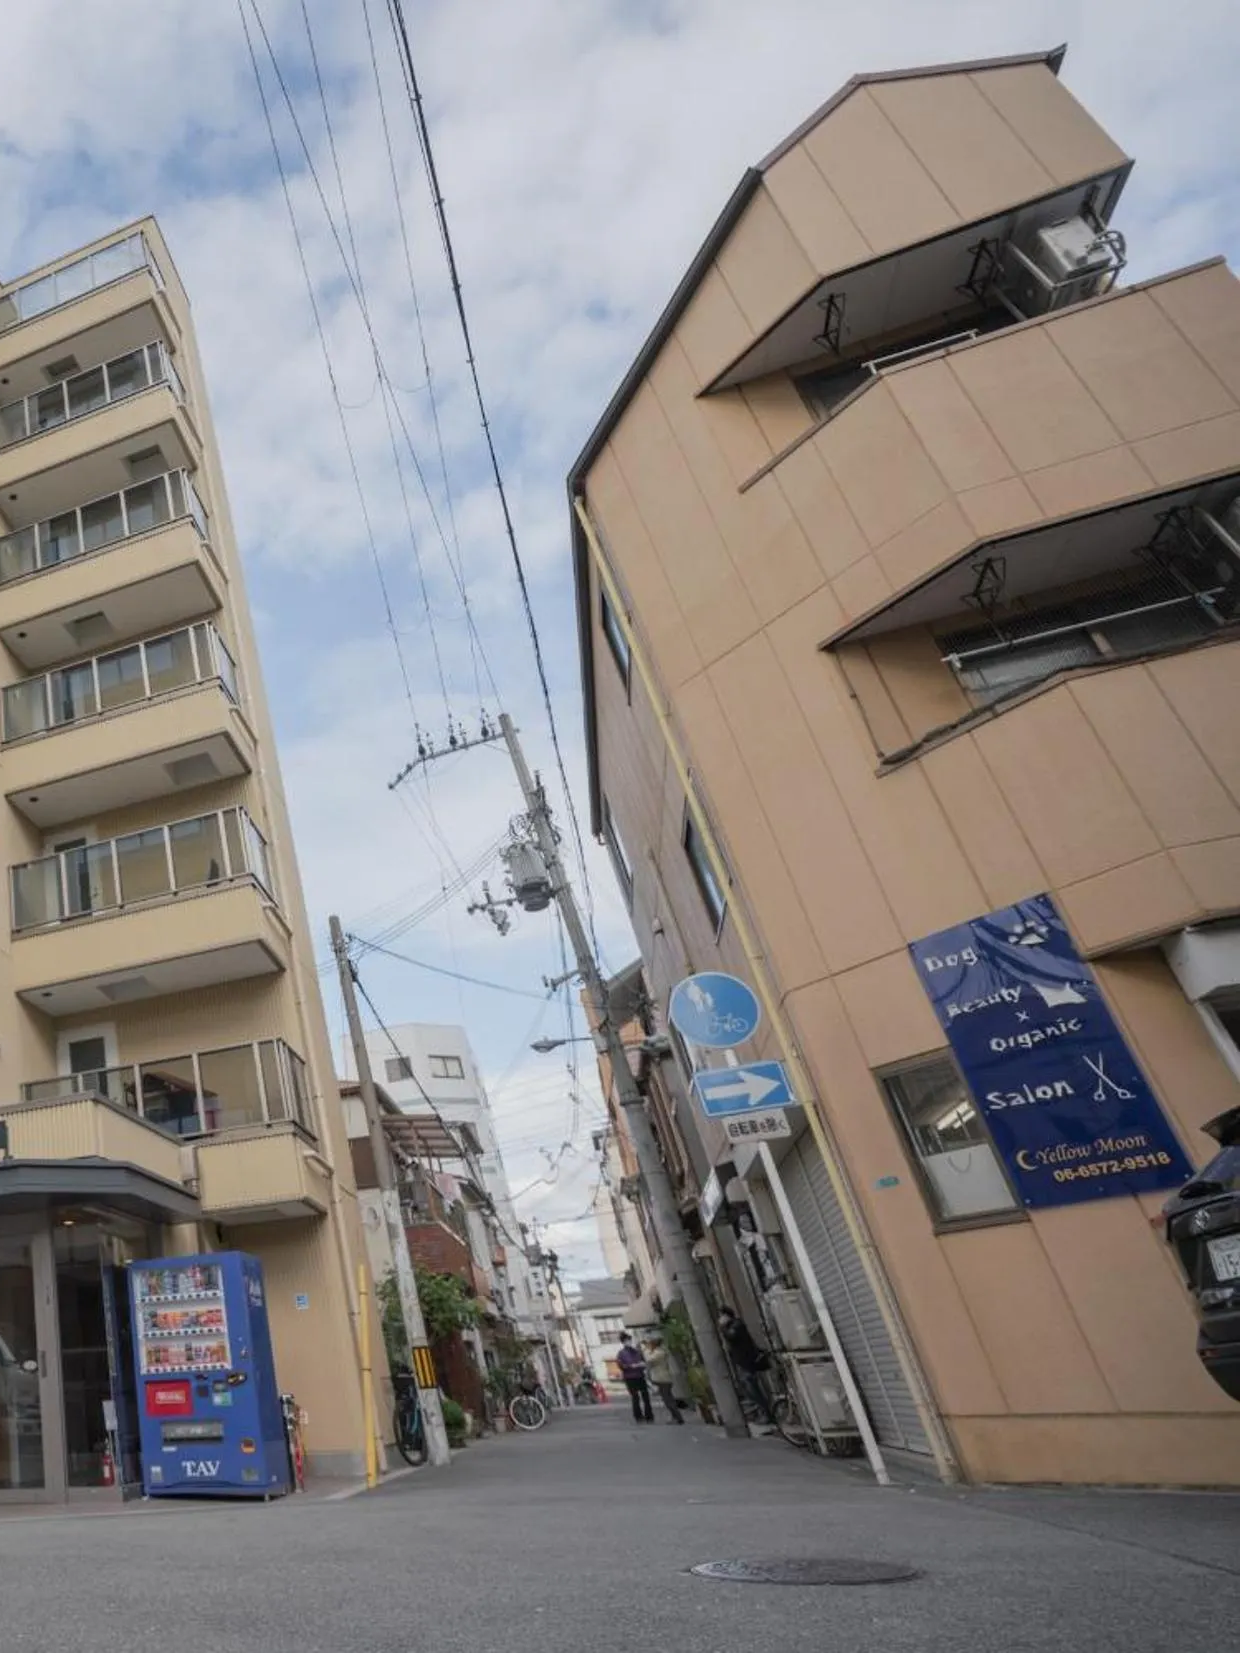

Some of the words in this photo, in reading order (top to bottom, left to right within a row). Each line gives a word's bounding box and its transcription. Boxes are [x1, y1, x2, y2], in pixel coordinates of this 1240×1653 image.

[923, 946, 978, 973] Dog
[946, 985, 1022, 1018] Beauty
[989, 1016, 1082, 1052] Organic
[986, 1080, 1075, 1110] Salon
[1035, 1143, 1091, 1165] Yellow
[1093, 1134, 1148, 1155] Moon
